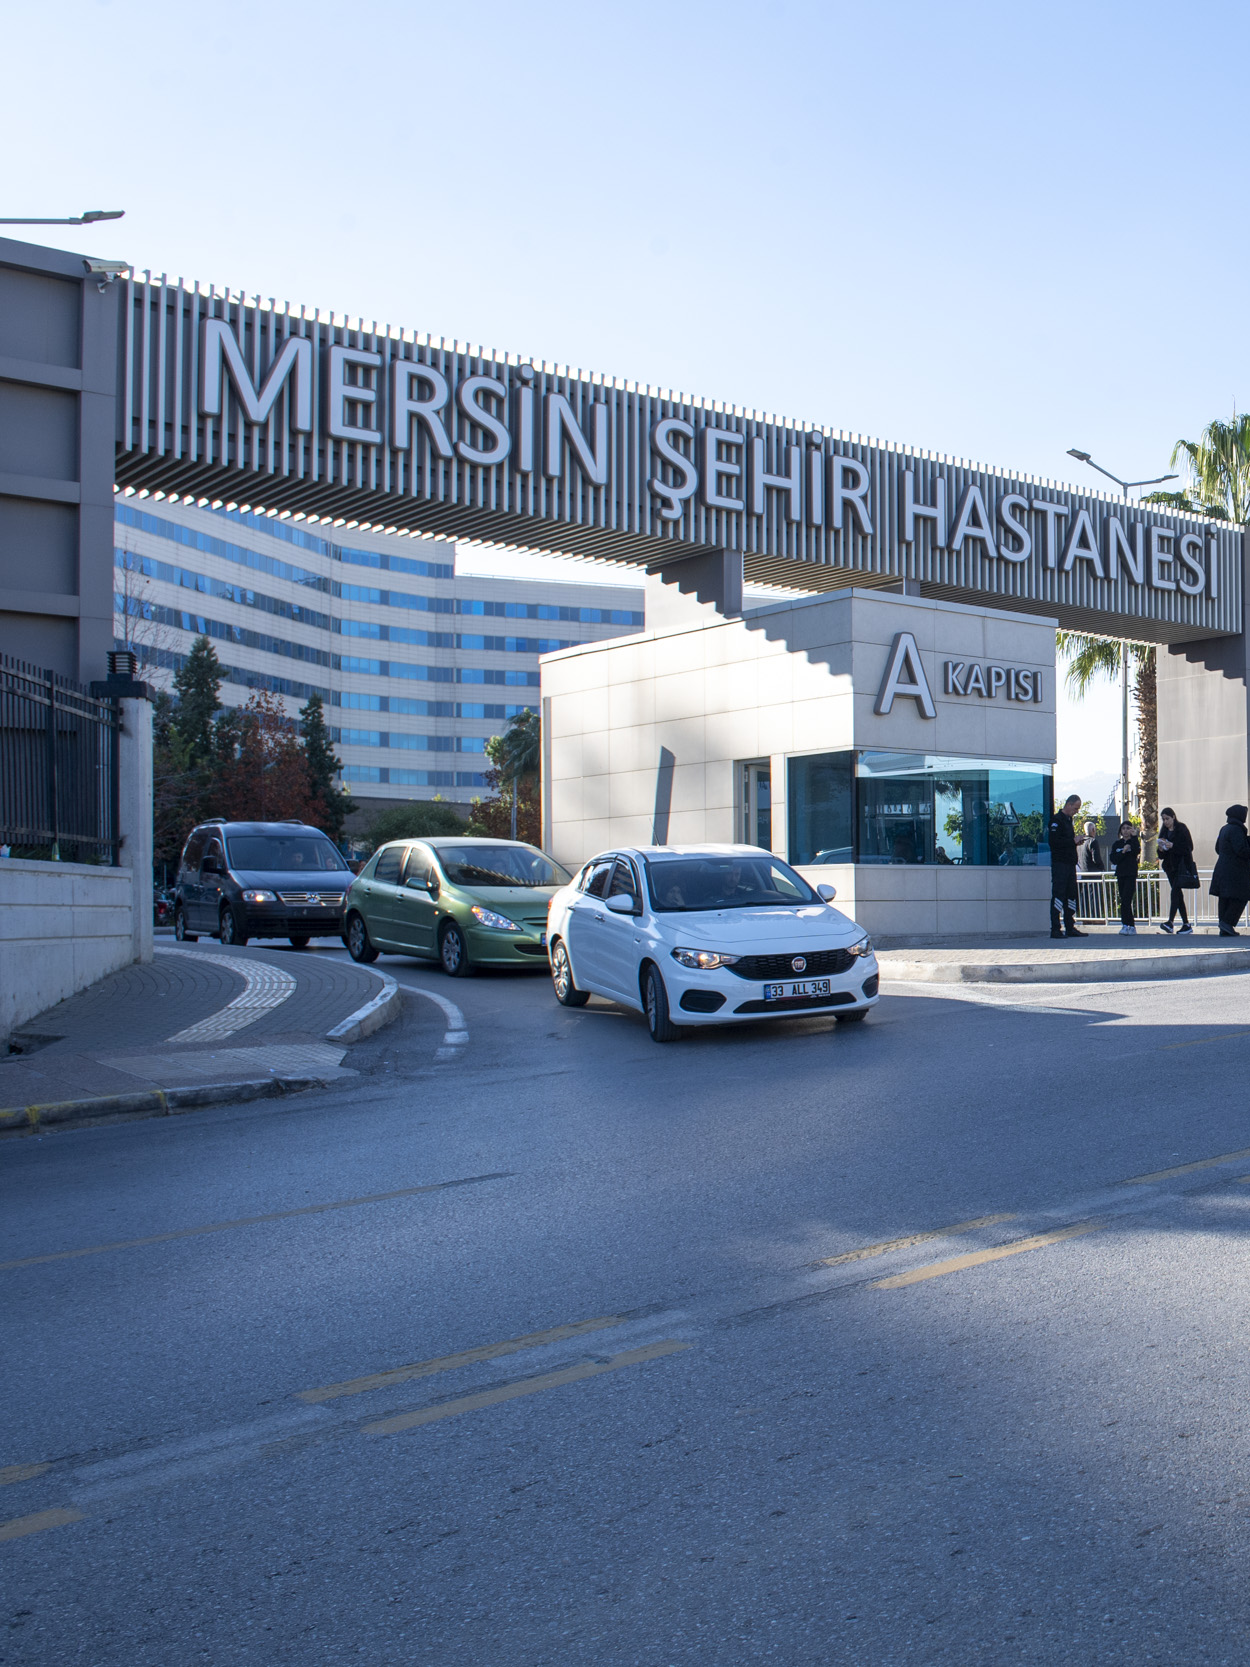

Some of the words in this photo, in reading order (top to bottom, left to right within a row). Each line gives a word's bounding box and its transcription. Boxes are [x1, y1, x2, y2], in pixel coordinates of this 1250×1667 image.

[201, 317, 609, 488] MERSİN
[648, 417, 874, 537] ŞEHİR
[901, 468, 1218, 600] HASTANESİ
[873, 631, 937, 720] A
[944, 661, 1043, 703] KAPISI
[771, 985, 784, 997] 33
[792, 983, 809, 996] ALL
[811, 981, 828, 994] 349
